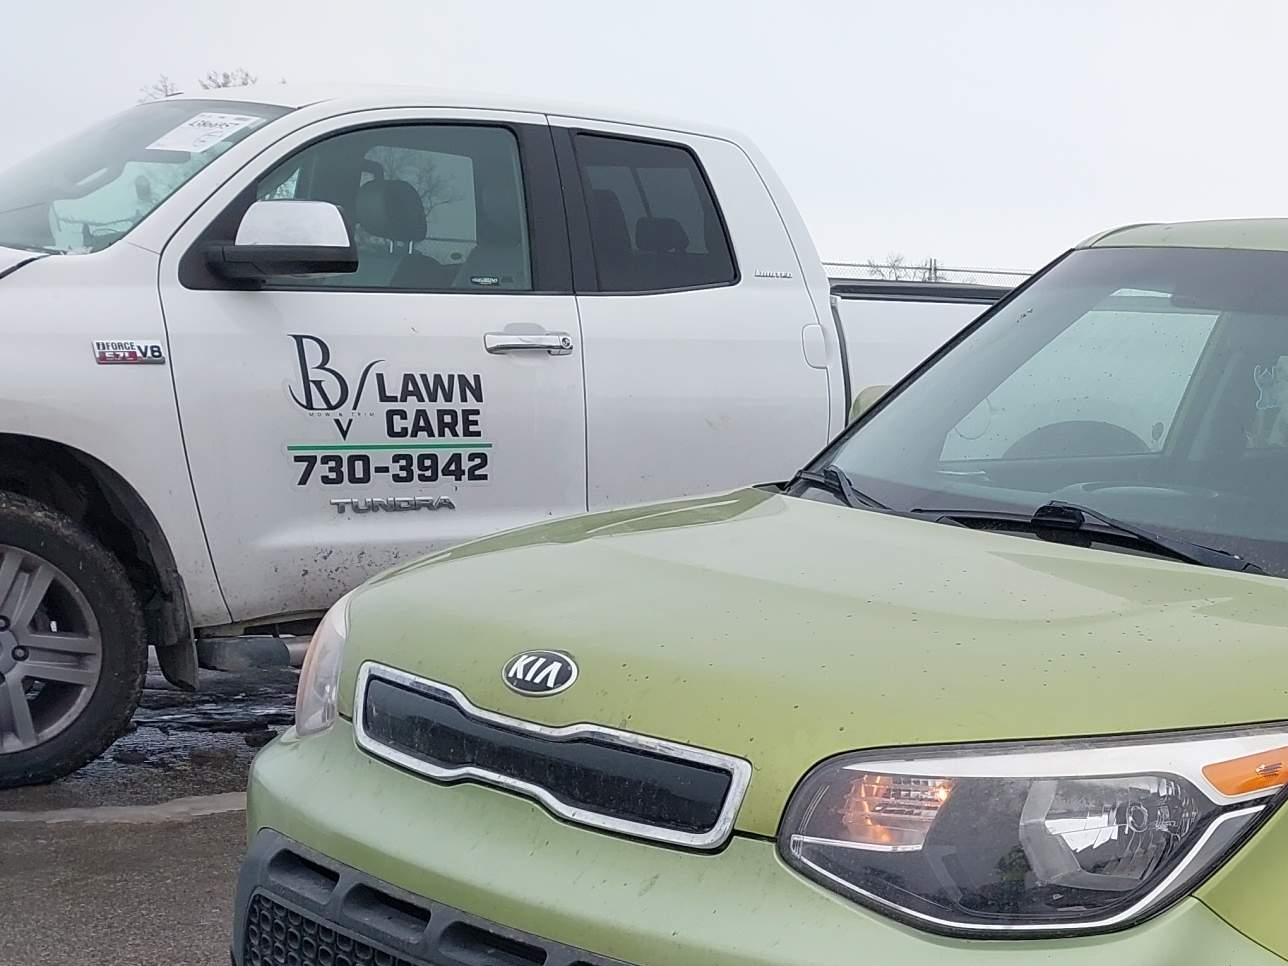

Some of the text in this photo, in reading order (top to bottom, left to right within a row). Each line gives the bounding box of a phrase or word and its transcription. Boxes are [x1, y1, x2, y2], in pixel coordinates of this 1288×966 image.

[137, 344, 163, 358] V8
[375, 373, 484, 403] LAWN
[385, 408, 482, 438] CARE
[293, 452, 489, 486] 730-3942
[329, 496, 456, 514] TUNDRA
[507, 655, 563, 688] KIA
